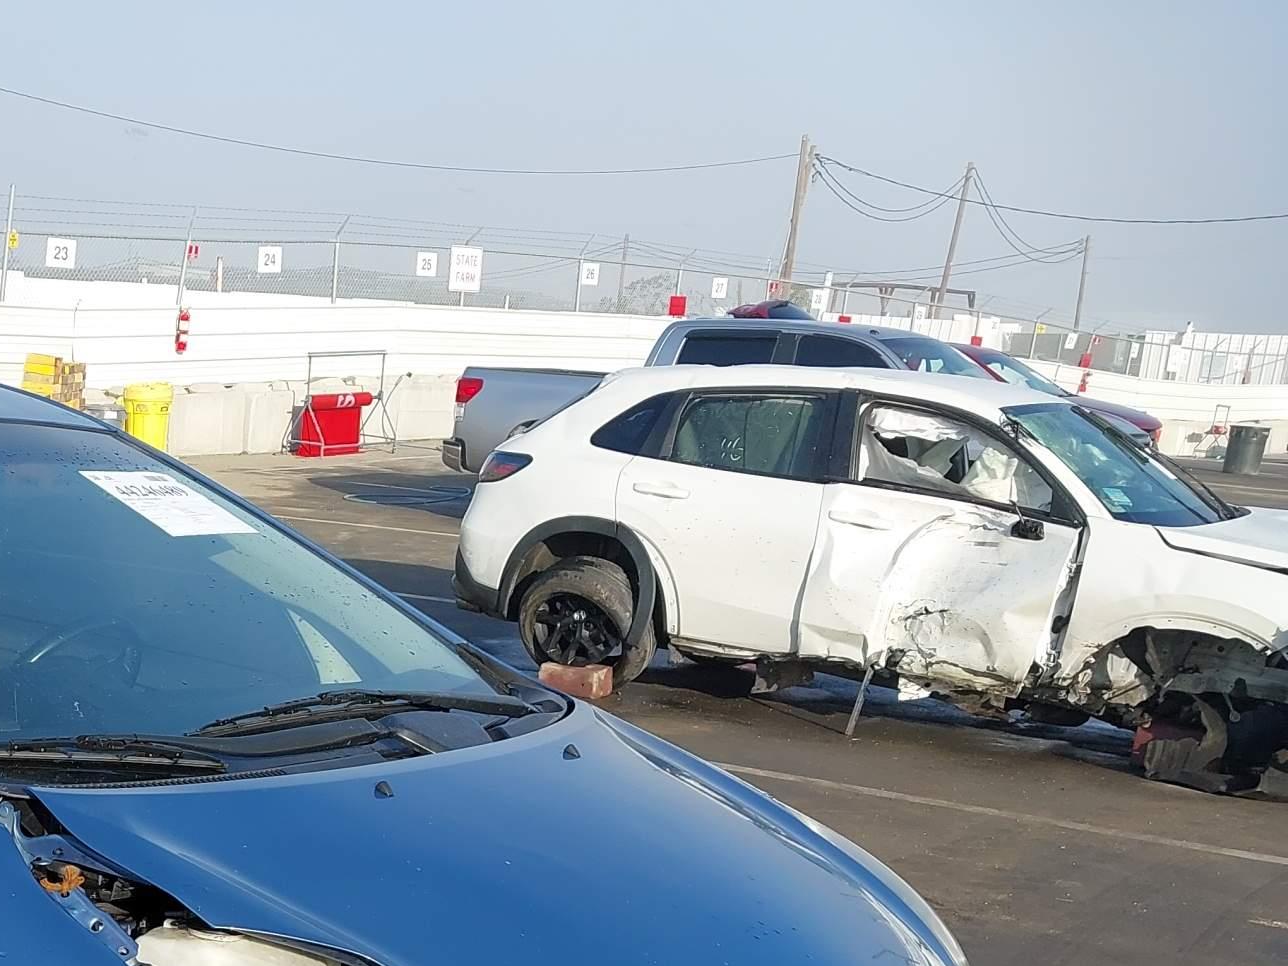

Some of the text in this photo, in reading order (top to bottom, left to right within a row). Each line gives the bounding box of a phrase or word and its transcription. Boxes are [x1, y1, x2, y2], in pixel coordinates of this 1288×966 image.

[54, 246, 69, 261] 23
[263, 253, 276, 266] 24
[455, 254, 479, 267] STATE
[455, 272, 476, 284] FARM
[585, 268, 595, 280] 26
